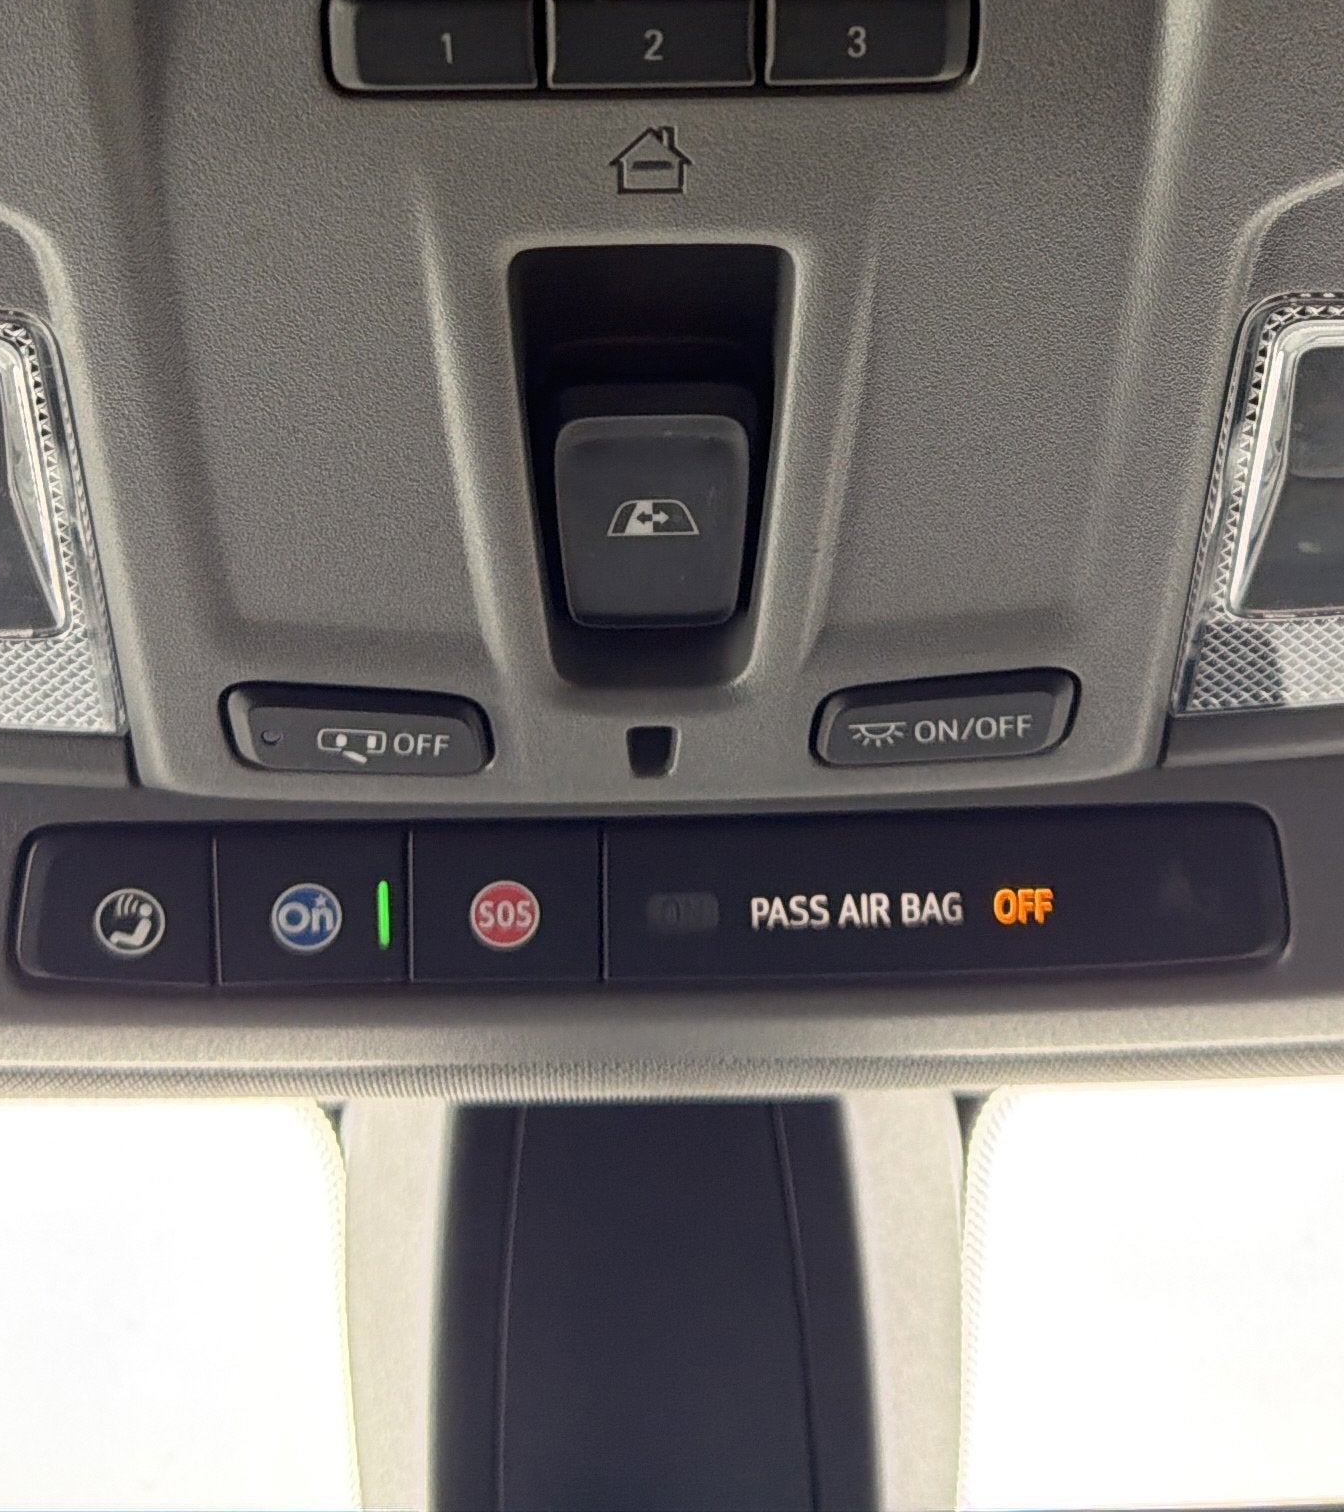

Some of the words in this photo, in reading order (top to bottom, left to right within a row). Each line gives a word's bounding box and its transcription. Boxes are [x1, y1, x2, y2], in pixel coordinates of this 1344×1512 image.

[440, 32, 454, 65] 1
[643, 29, 664, 61] 2
[847, 25, 867, 58] 3
[392, 732, 450, 756] OFF
[914, 714, 1032, 743] ON/OFF
[277, 902, 335, 934] On
[478, 899, 532, 929] SOS
[750, 895, 830, 929] PASS
[838, 893, 892, 925] AIR
[902, 891, 963, 923] BAG
[993, 888, 1053, 924] OFF
